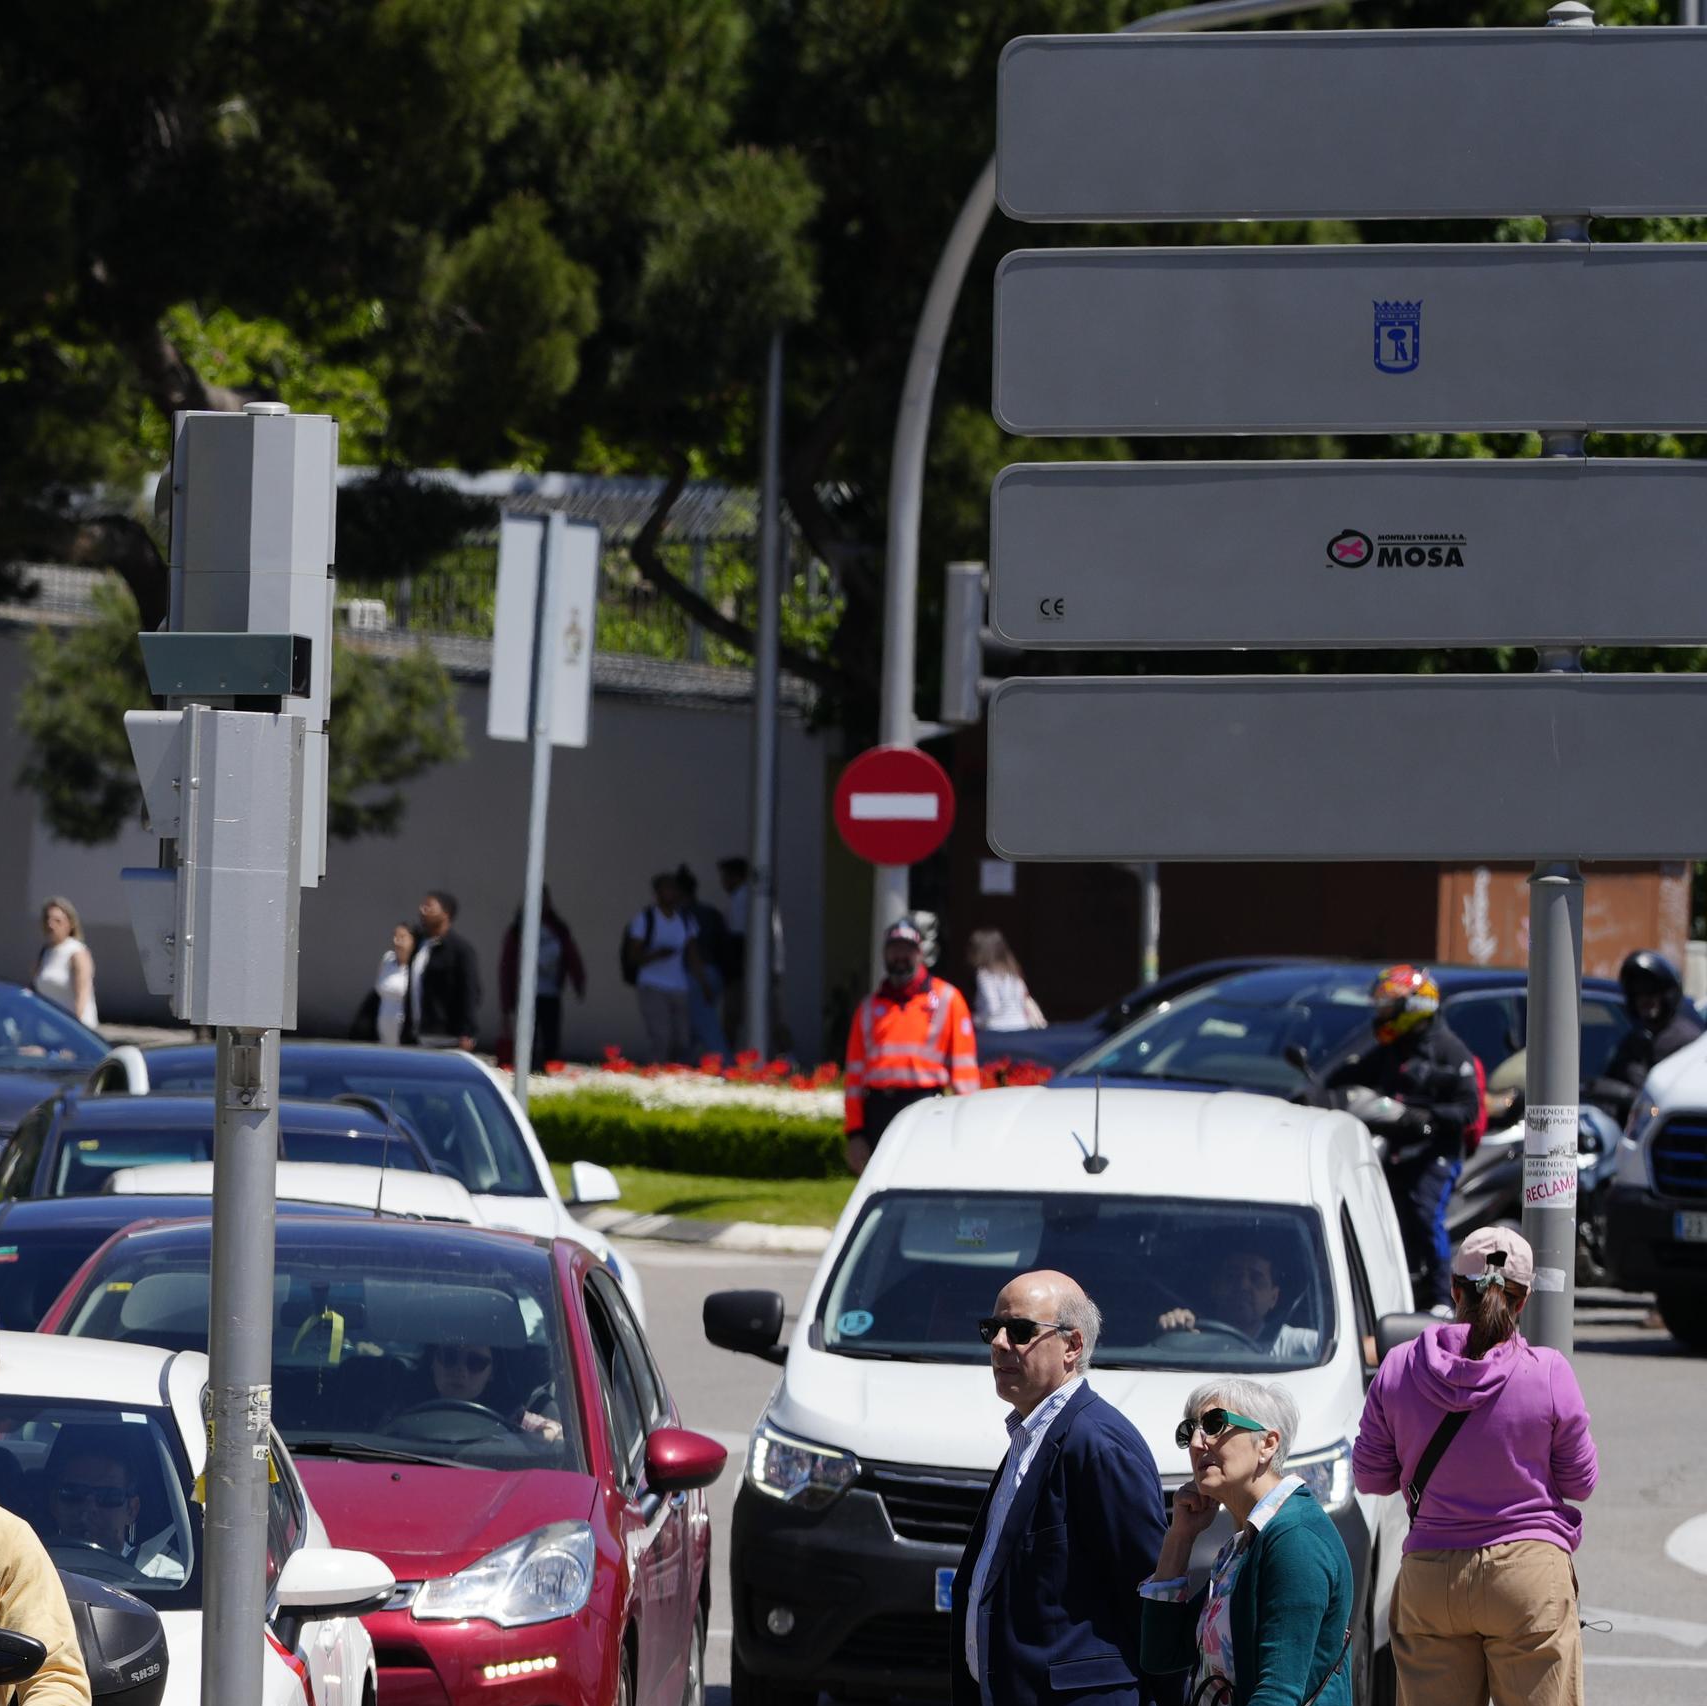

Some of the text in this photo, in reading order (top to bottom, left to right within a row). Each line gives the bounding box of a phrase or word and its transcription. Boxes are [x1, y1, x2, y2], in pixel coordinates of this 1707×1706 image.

[1377, 547, 1464, 567] MOSA
[1040, 598, 1064, 616] CE
[1529, 1108, 1564, 1116] DEFIENDE
[1525, 1175, 1576, 1204] RECLAMA
[130, 1663, 161, 1682] SH39
